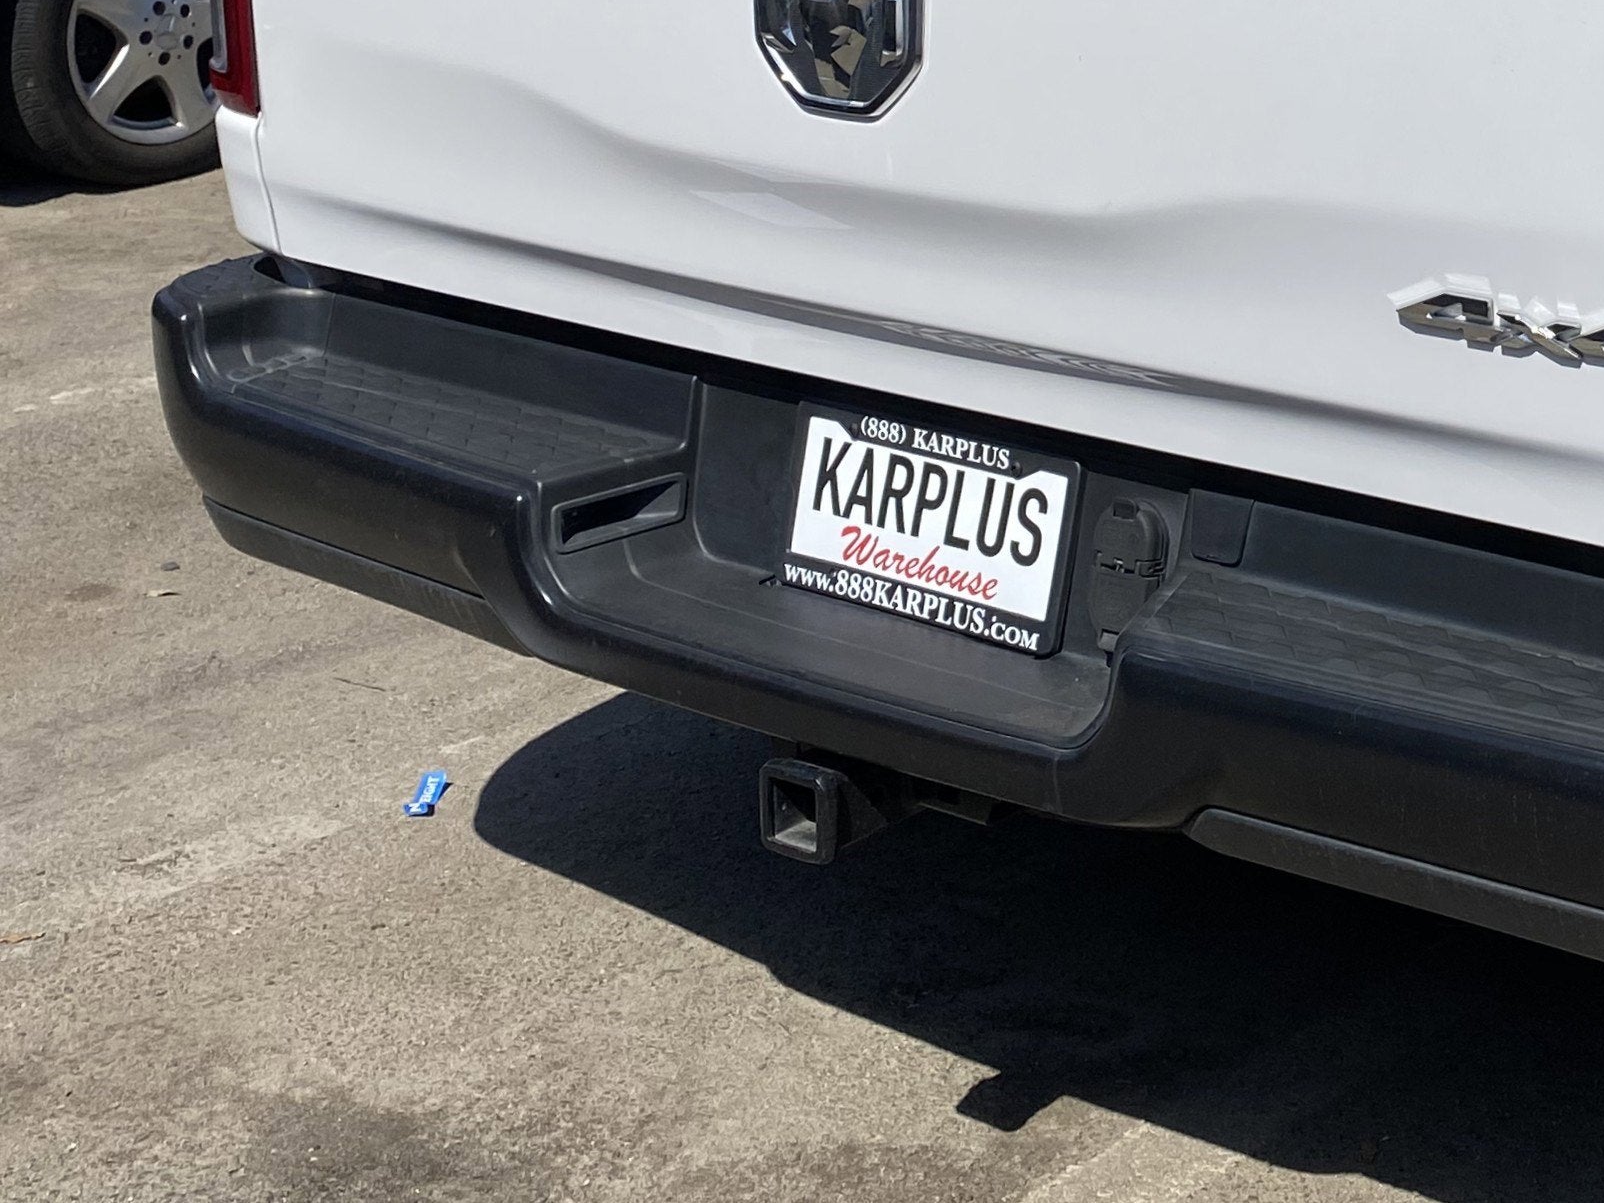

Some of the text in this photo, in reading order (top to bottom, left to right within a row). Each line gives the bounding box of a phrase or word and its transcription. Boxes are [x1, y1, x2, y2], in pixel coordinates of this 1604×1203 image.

[860, 415, 1011, 470] (888) KARPLUS
[812, 436, 1049, 567] KARPLUS
[840, 525, 999, 601] Warehouse
